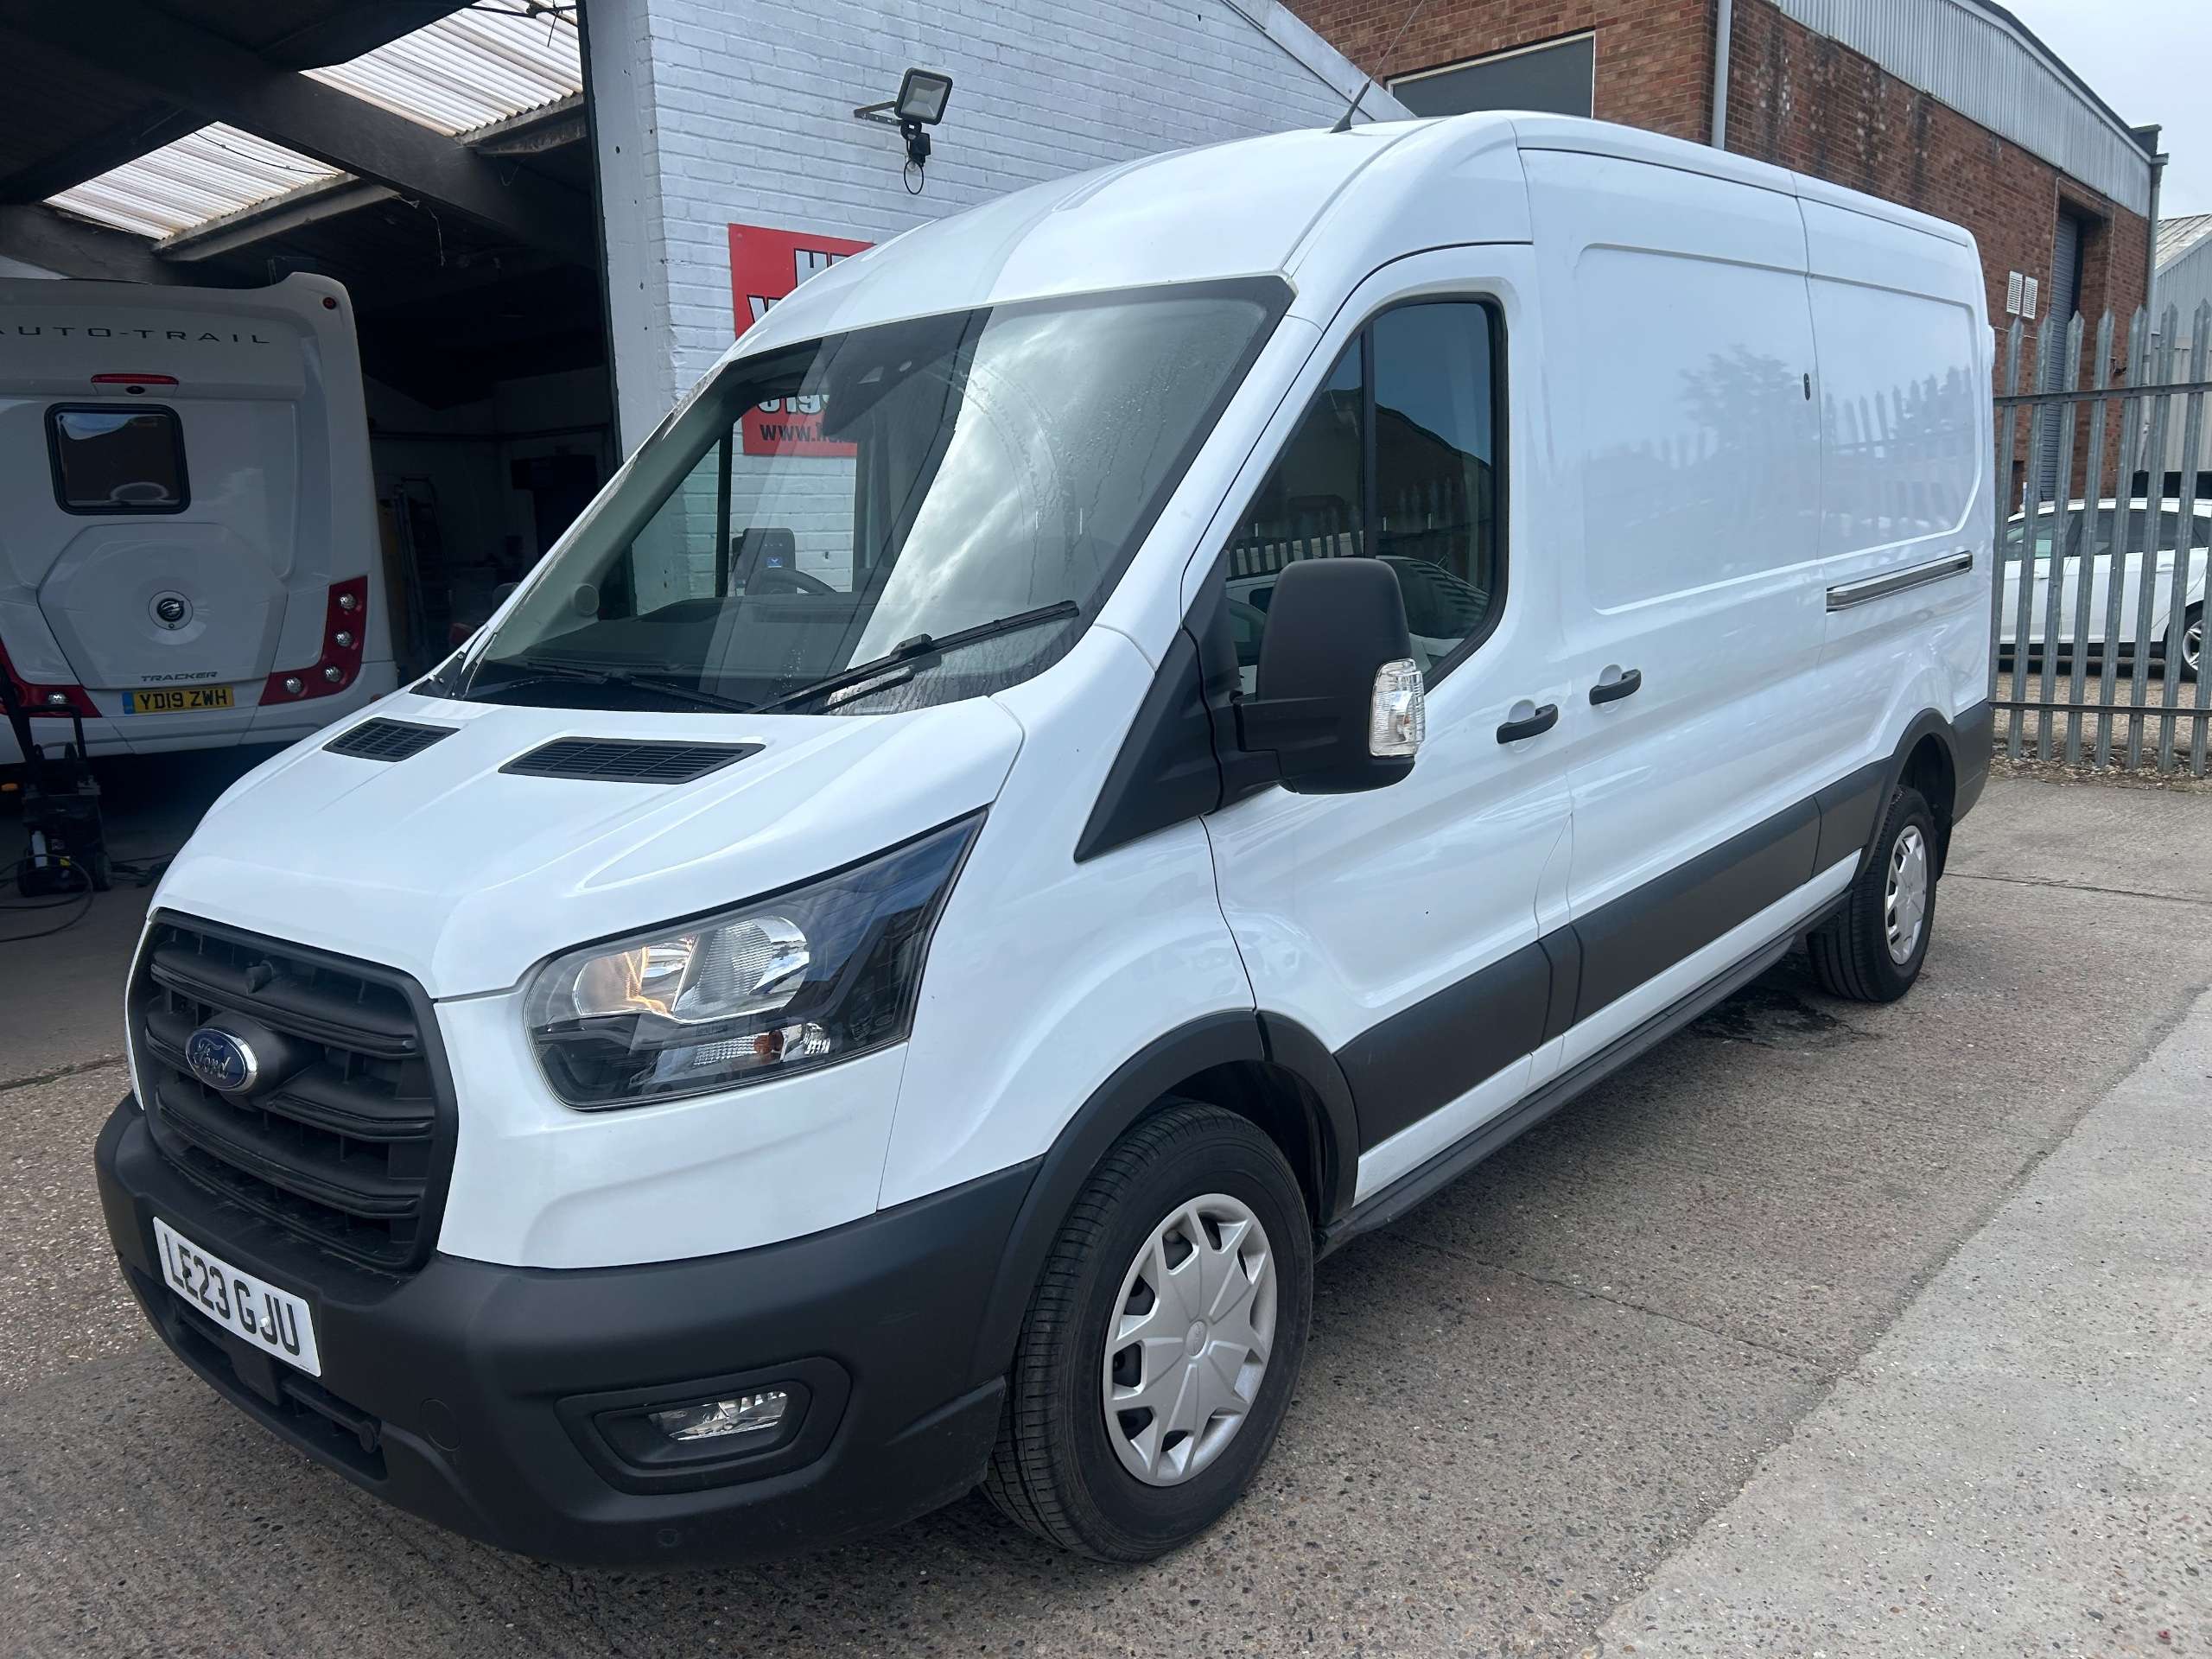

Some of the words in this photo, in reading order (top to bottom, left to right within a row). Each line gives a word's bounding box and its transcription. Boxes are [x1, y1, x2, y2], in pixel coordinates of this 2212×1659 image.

[0, 326, 270, 344] UTO-TRAIL
[141, 671, 218, 682] TRACKER
[140, 693, 184, 709] YD19
[189, 690, 227, 706] ZWH
[193, 1038, 231, 1079] Ford
[164, 1232, 230, 1320] LE23
[233, 1279, 300, 1357] GJU
